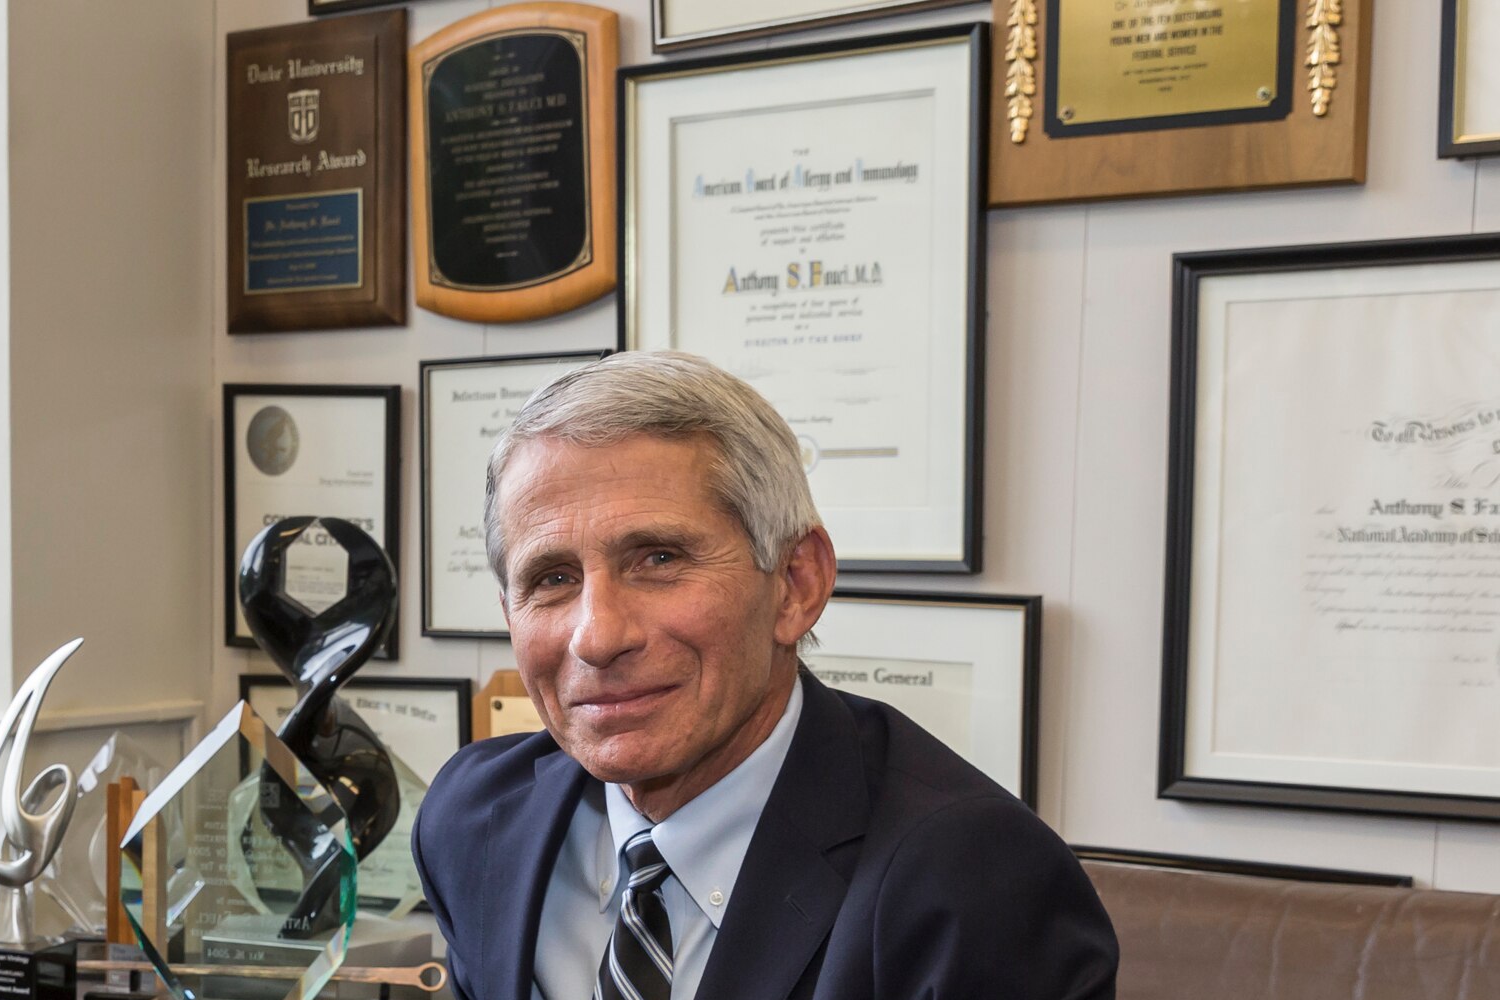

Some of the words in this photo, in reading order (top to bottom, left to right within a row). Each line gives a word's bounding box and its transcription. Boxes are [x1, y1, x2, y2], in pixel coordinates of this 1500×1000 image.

[247, 64, 283, 84] Duke
[288, 56, 364, 79] University
[246, 155, 311, 177] Research
[316, 149, 367, 171] Award
[694, 173, 742, 198] American
[745, 167, 775, 193] Board
[779, 171, 791, 189] of
[792, 163, 832, 191] Allergy
[855, 158, 919, 183] Immunology
[722, 266, 779, 297] Anthony
[787, 261, 806, 289] S.
[1369, 498, 1444, 519] Anthony
[1337, 527, 1397, 544] National
[1398, 526, 1458, 546] Academy
[1459, 527, 1475, 544] of
[873, 667, 933, 687] General
